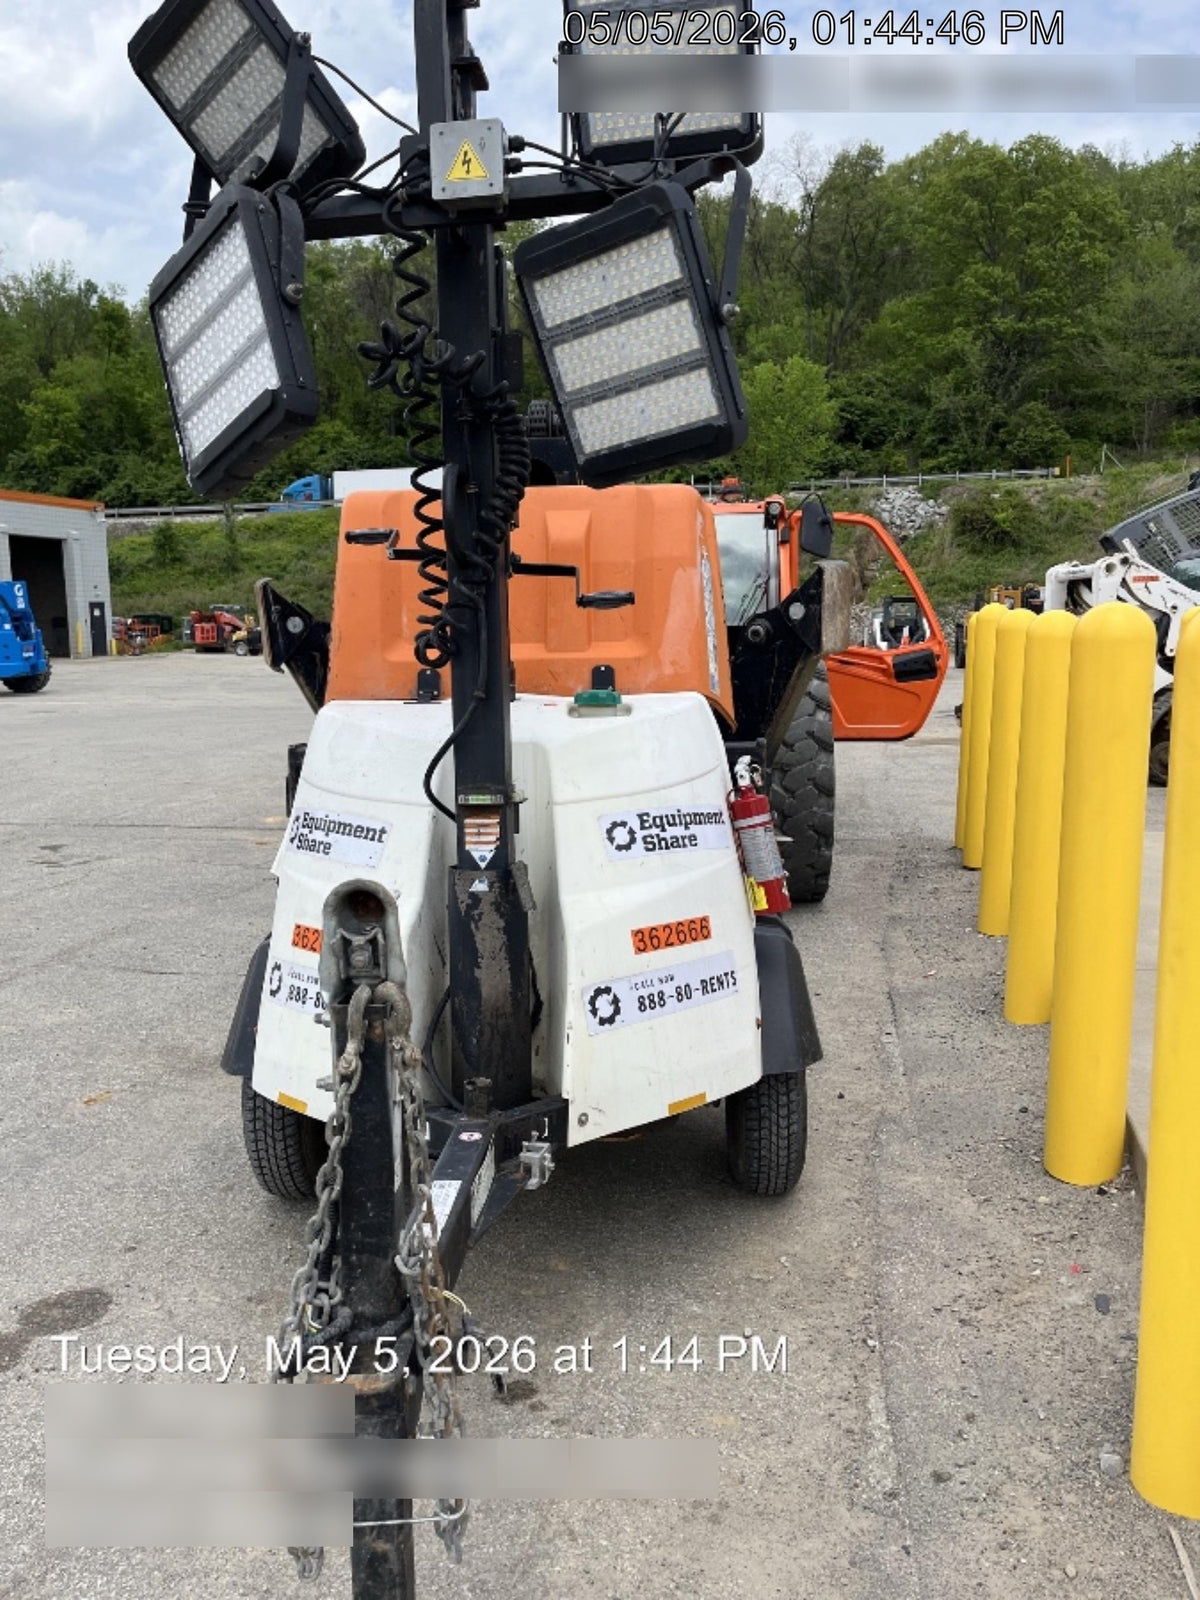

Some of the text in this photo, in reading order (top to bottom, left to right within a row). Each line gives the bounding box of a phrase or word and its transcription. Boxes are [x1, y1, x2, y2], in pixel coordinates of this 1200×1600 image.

[301, 812, 387, 843] Equipment
[296, 832, 332, 855] Share
[641, 833, 698, 852] Share
[292, 924, 318, 952] 362
[634, 917, 711, 952] 362666
[637, 970, 737, 1013] 888-80-RENTS
